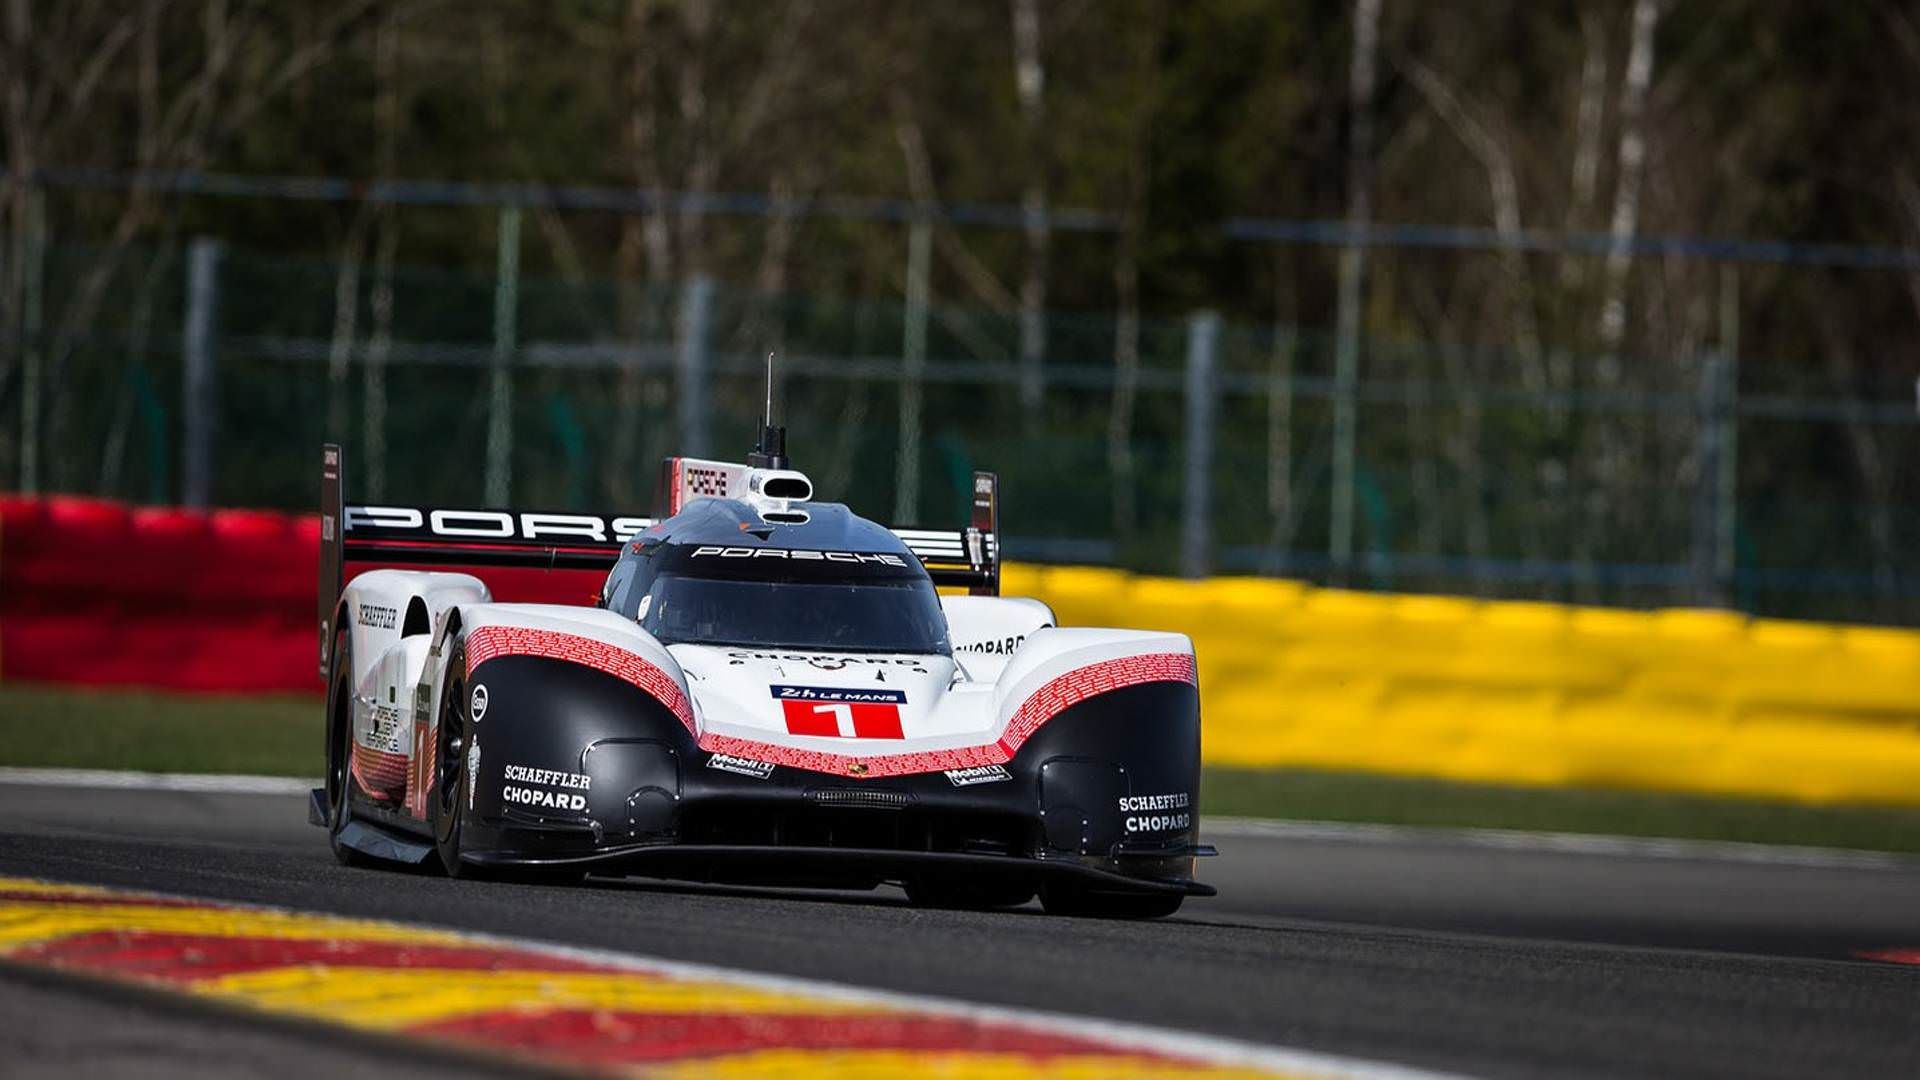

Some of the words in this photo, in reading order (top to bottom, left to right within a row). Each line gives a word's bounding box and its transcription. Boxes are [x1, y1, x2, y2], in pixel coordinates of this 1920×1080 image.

[687, 468, 727, 496] PORSCHE
[690, 546, 908, 568] PORSCHE
[358, 604, 397, 629] SCHAEFFLER
[819, 692, 842, 700] LE
[844, 693, 898, 702] MANS
[812, 702, 858, 738] 1
[711, 753, 758, 769] Mobil
[943, 765, 990, 779] Mobil
[503, 764, 592, 790] SCHAEFFLER
[502, 785, 587, 811] CHOPARD
[1118, 792, 1190, 812] SCHAEFFLER
[1126, 813, 1190, 832] CHOPARD
